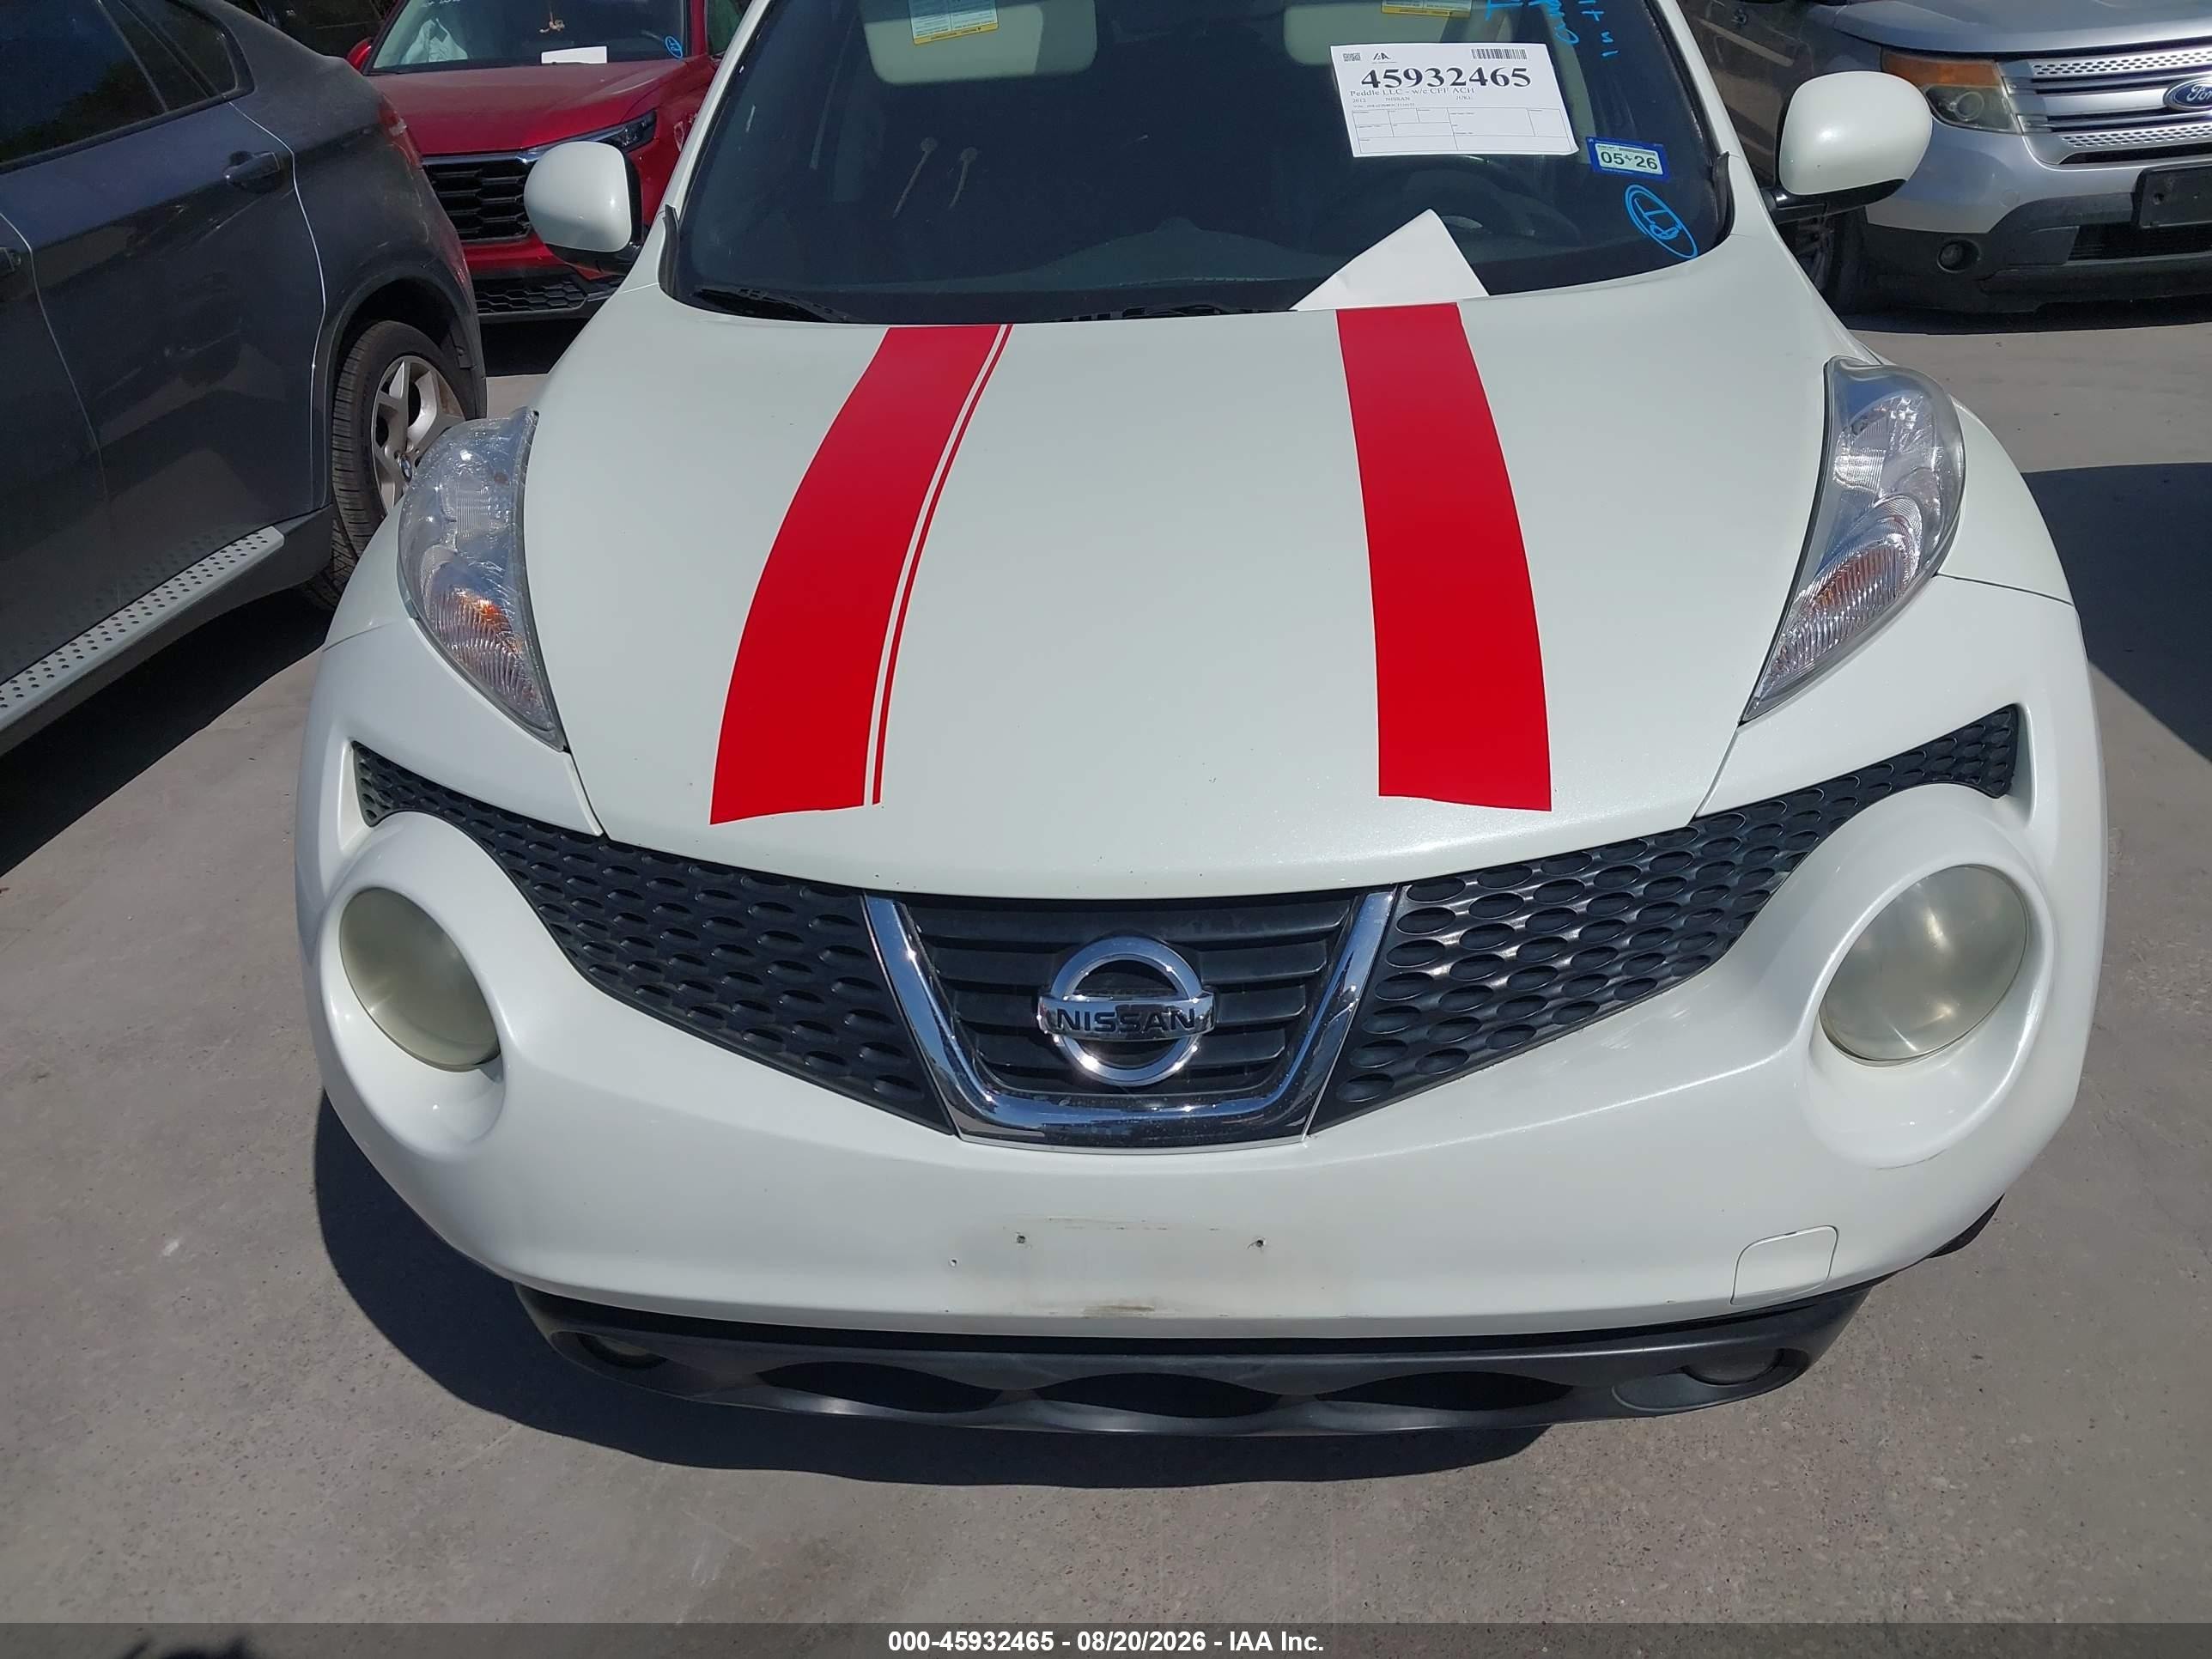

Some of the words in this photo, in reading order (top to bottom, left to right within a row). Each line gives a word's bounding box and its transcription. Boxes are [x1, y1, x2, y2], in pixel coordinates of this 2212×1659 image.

[1361, 67, 1531, 88] 45932465
[2186, 84, 2212, 102] For
[1600, 151, 1626, 166] 05
[1633, 155, 1658, 170] 26
[1056, 1008, 1195, 1033] NISSAN
